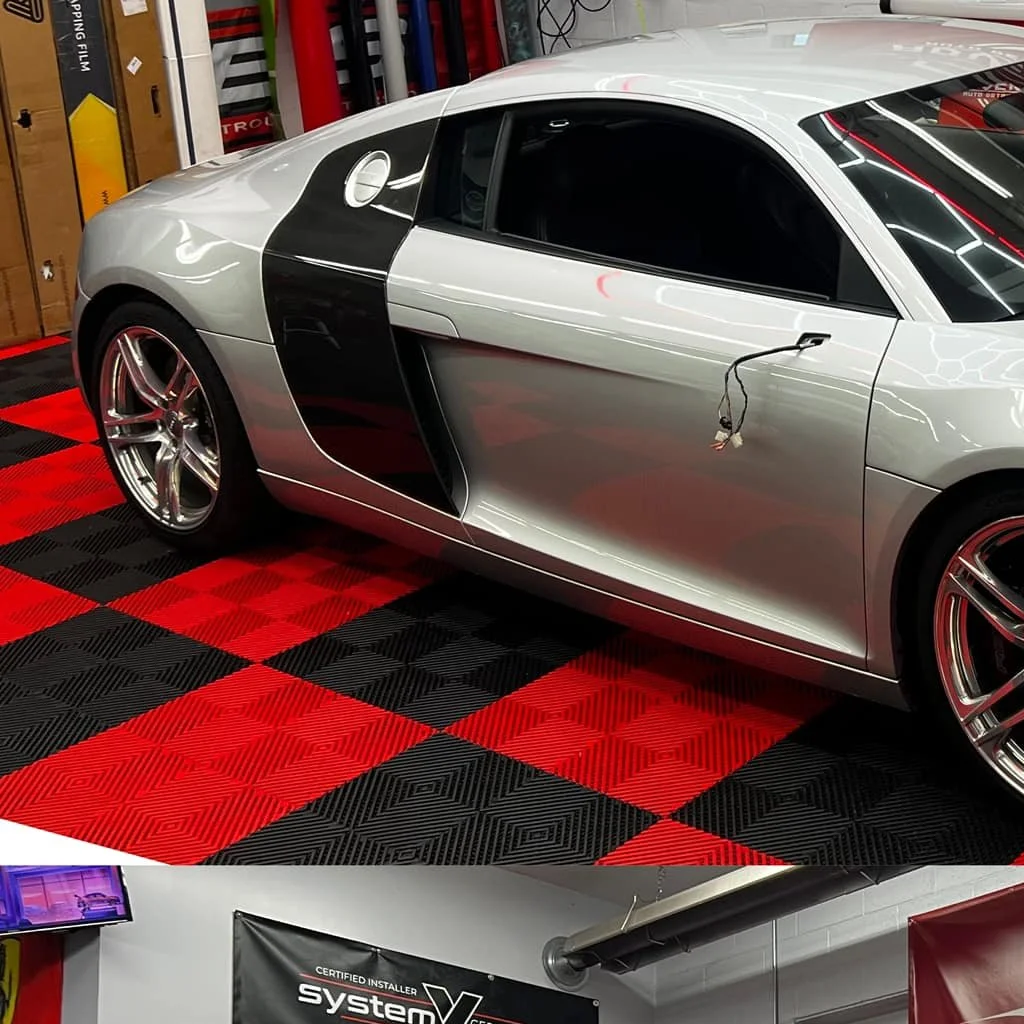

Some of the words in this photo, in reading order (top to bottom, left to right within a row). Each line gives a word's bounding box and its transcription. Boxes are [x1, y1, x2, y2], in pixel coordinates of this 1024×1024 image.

[77, 42, 91, 72] FILM
[315, 966, 367, 985] CERTIFIED
[368, 978, 418, 996] INSTALLER
